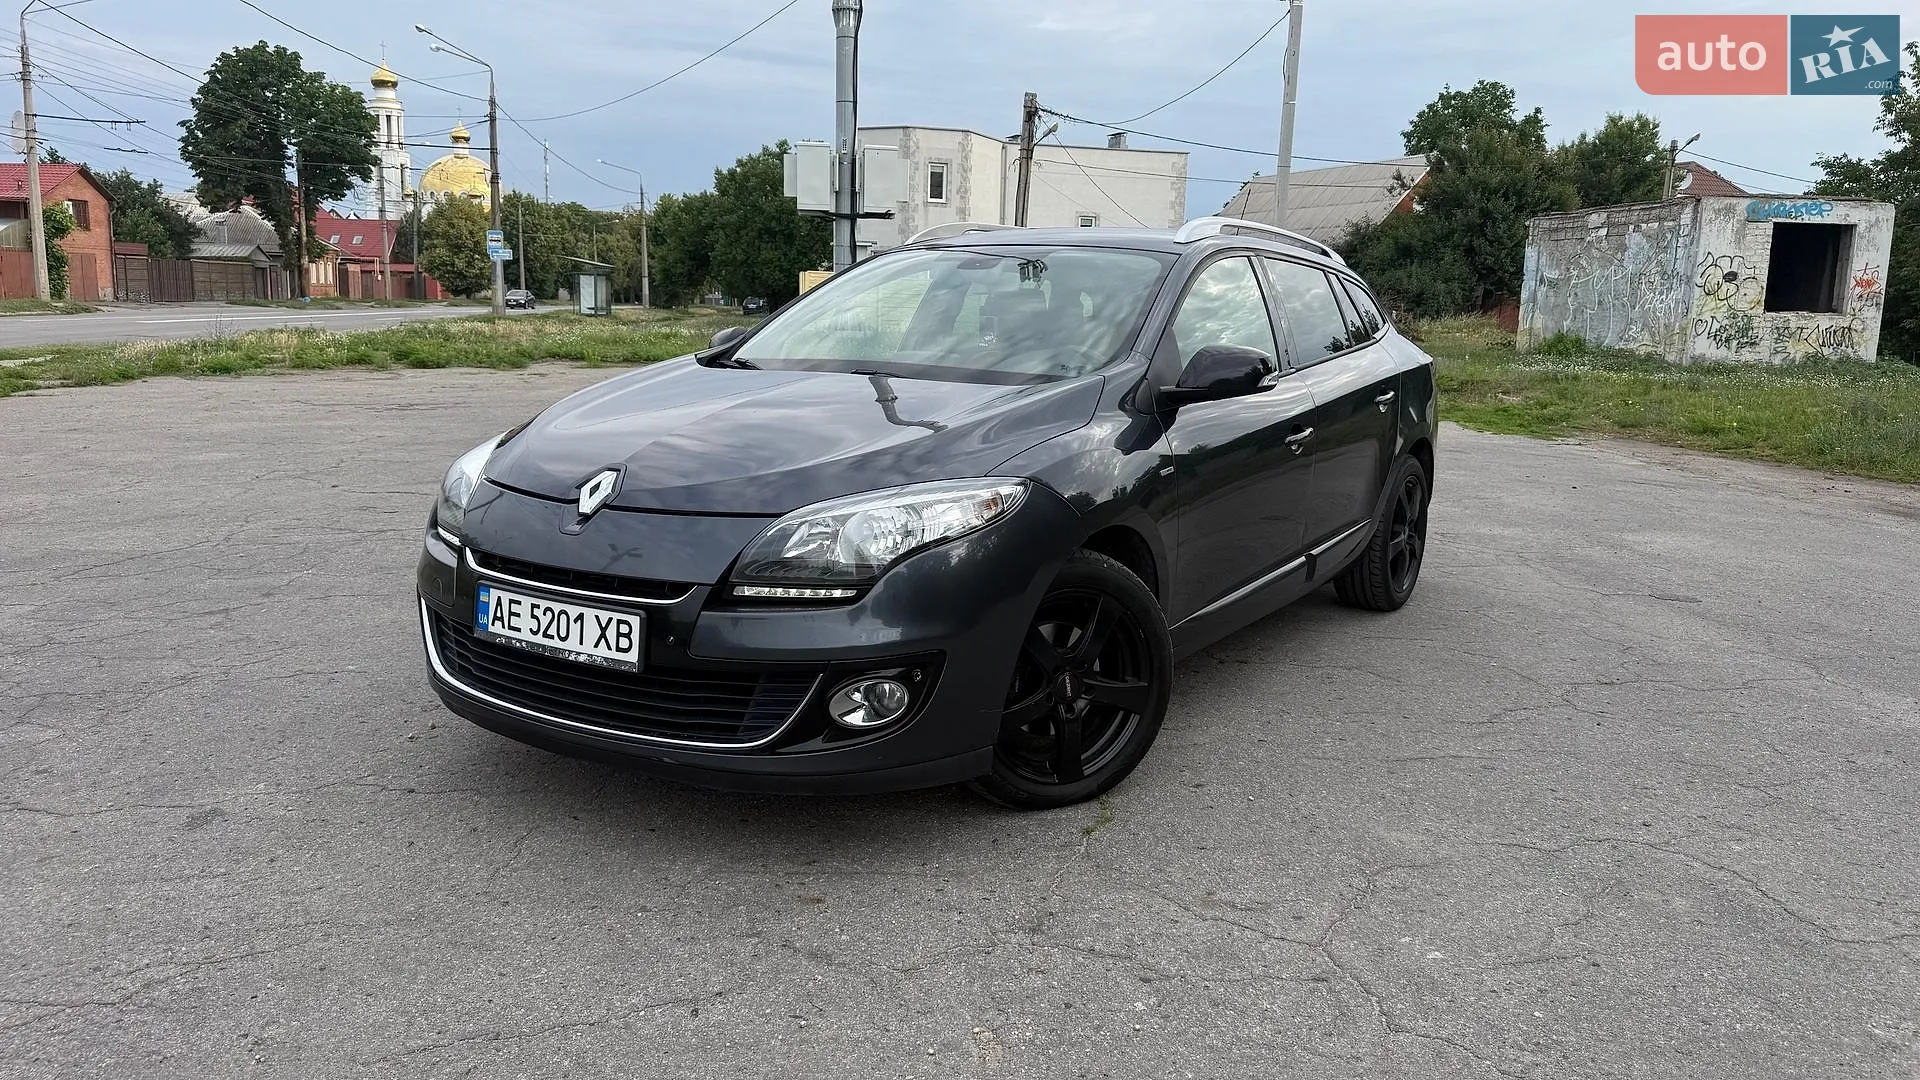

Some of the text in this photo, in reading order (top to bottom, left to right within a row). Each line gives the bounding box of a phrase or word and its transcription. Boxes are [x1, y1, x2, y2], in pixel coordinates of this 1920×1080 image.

[478, 613, 488, 625] UA
[491, 595, 633, 654] AE 5201 XB
